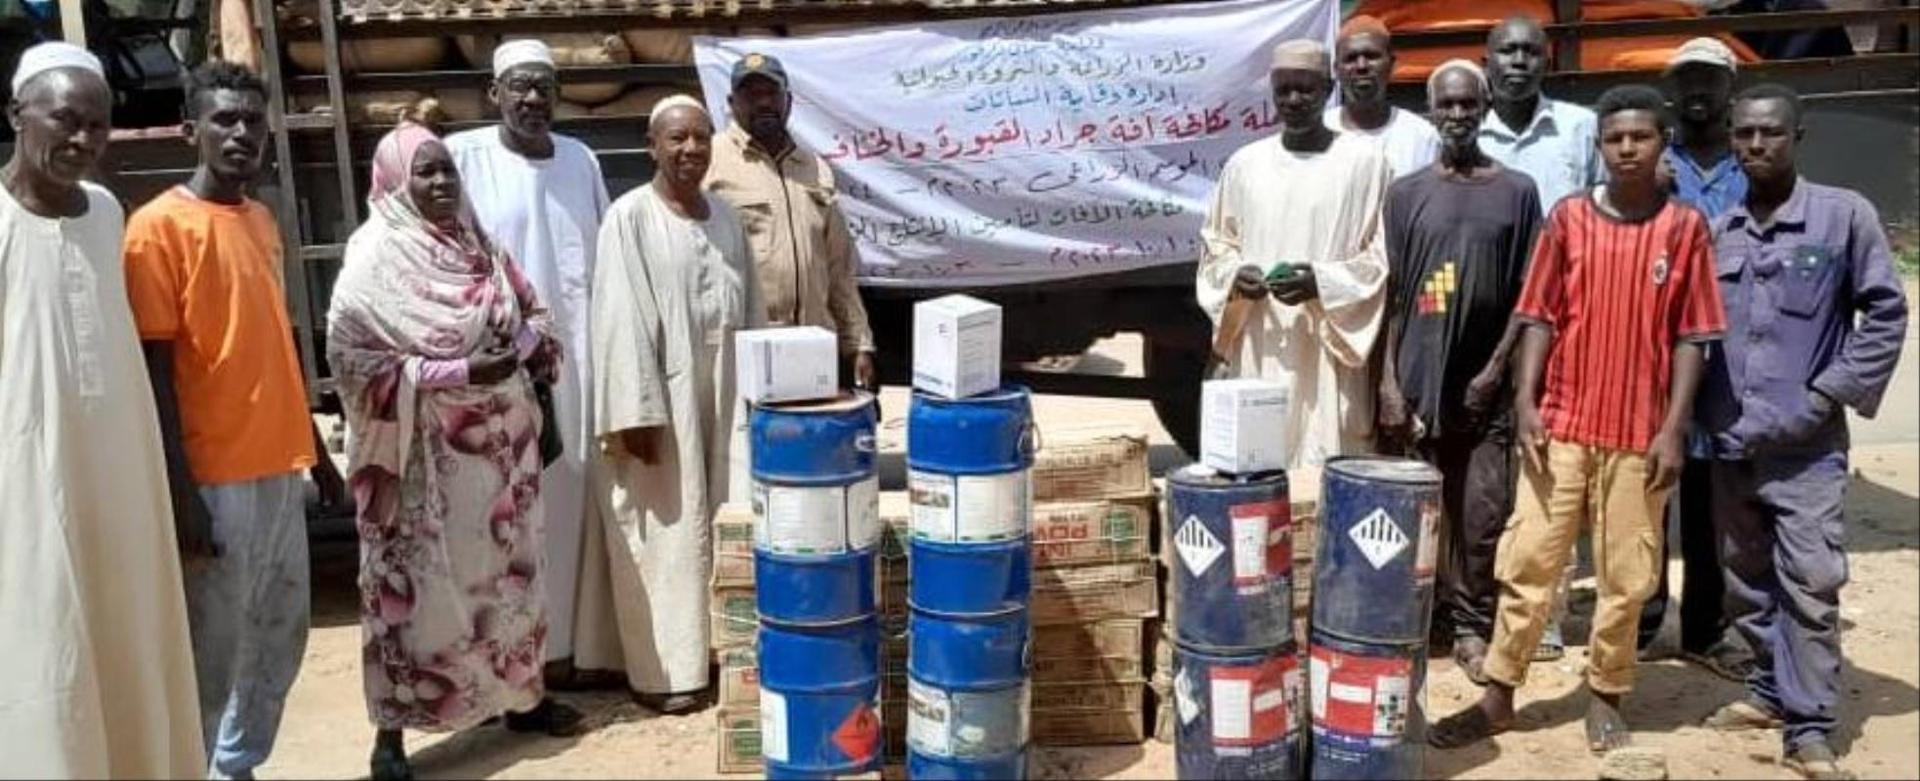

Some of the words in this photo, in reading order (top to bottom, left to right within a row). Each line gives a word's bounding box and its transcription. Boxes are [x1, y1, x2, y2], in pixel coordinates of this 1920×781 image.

[1150, 50, 1206, 75] وزارة
[1039, 116, 1098, 150] جراد
[1163, 99, 1231, 139] مكافحة
[819, 127, 925, 161] والخناف
[936, 114, 1032, 160] القبورة
